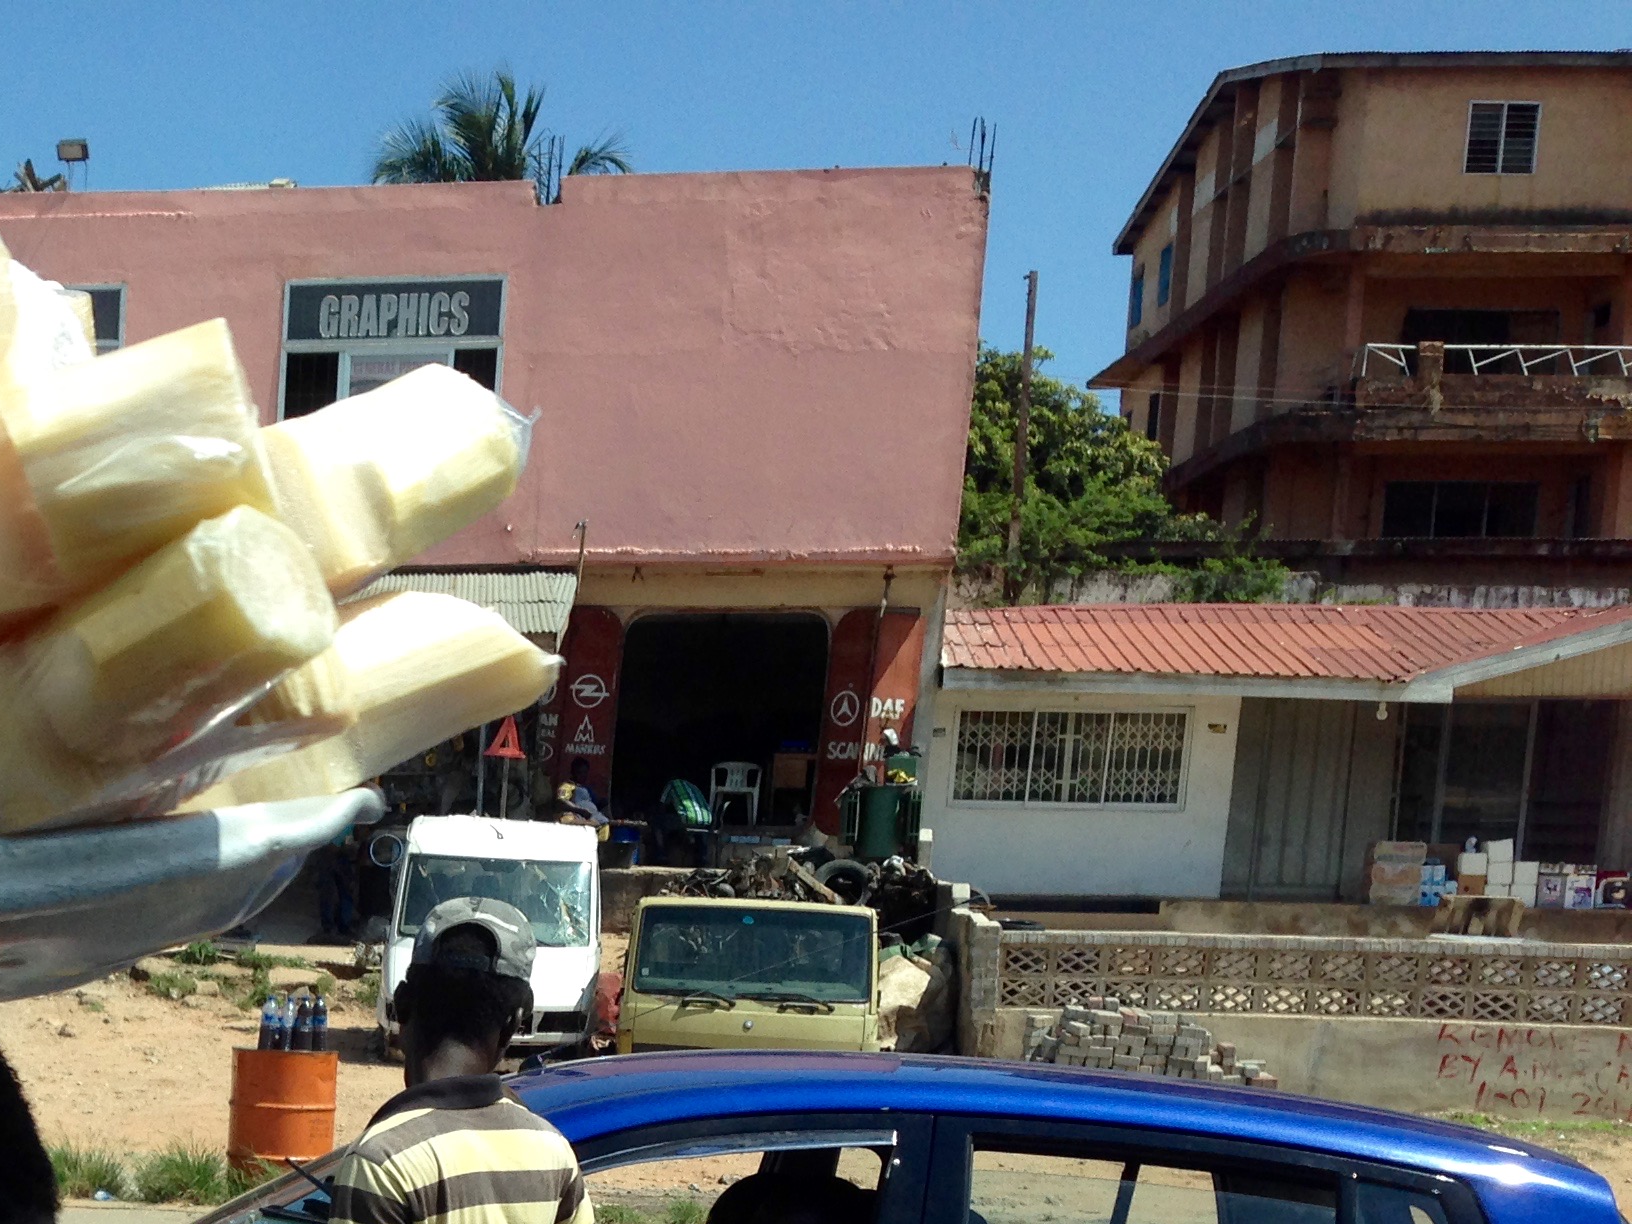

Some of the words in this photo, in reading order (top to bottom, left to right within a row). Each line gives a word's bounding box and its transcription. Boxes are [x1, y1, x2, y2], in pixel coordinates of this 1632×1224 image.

[319, 291, 470, 338] GRAPHICS
[870, 697, 905, 719] DAF
[1438, 1052, 1484, 1083] BY
